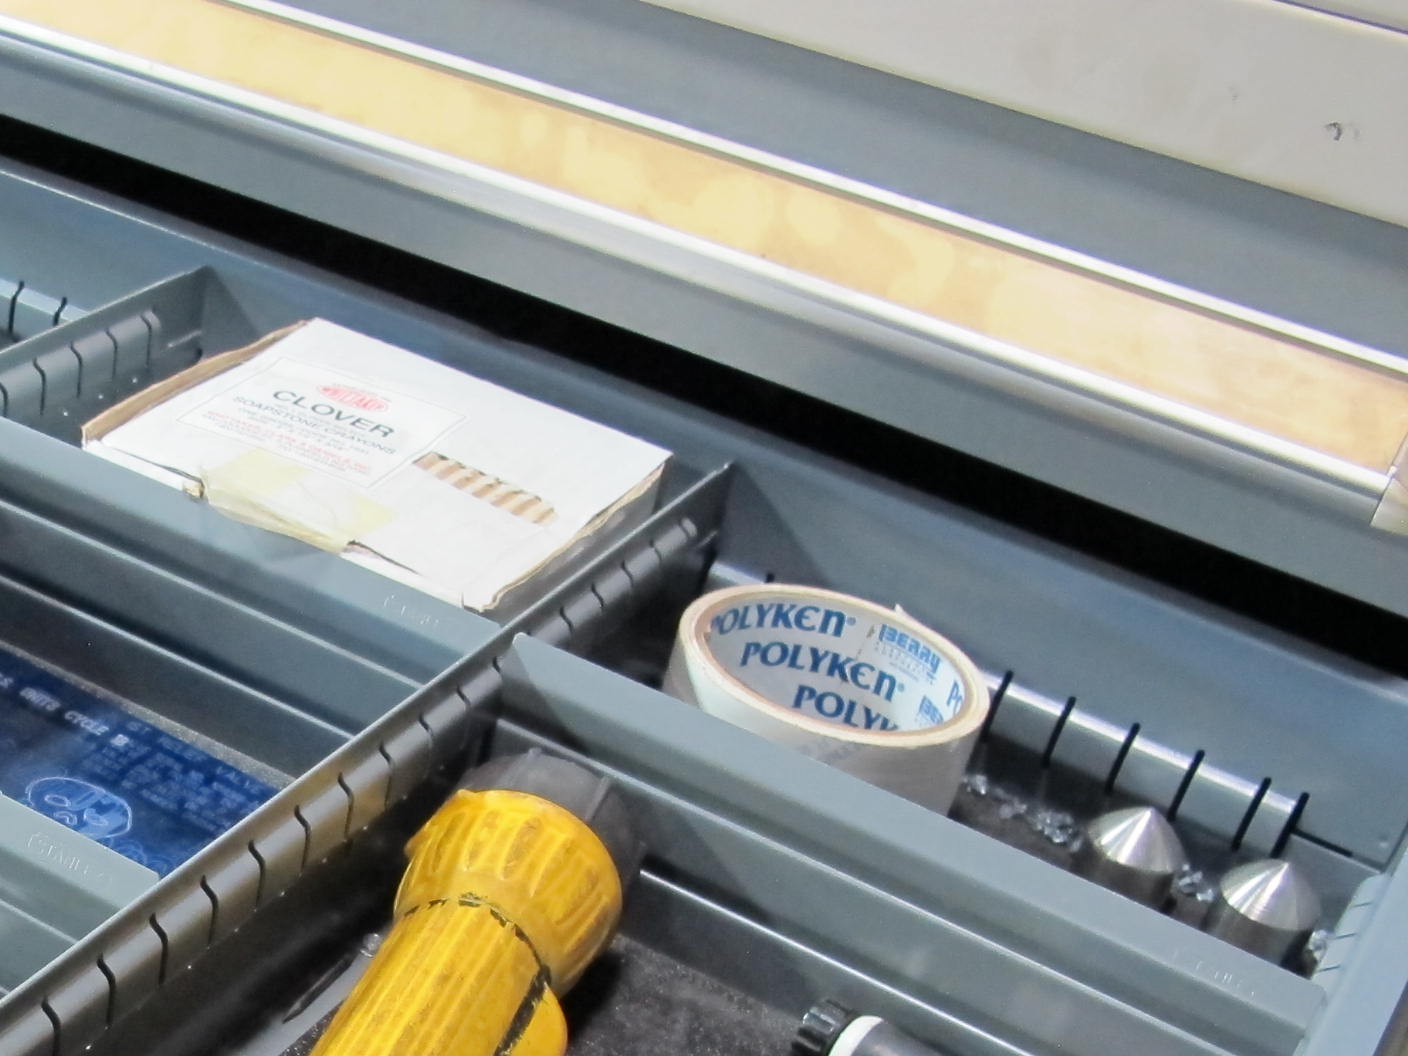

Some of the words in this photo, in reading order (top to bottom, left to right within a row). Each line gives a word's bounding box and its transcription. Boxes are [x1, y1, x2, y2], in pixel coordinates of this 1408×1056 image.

[232, 396, 323, 427] SOAPSTONE
[272, 389, 395, 438] CLOVER
[740, 641, 898, 702] POLYKEN
[879, 624, 941, 674] BERRY
